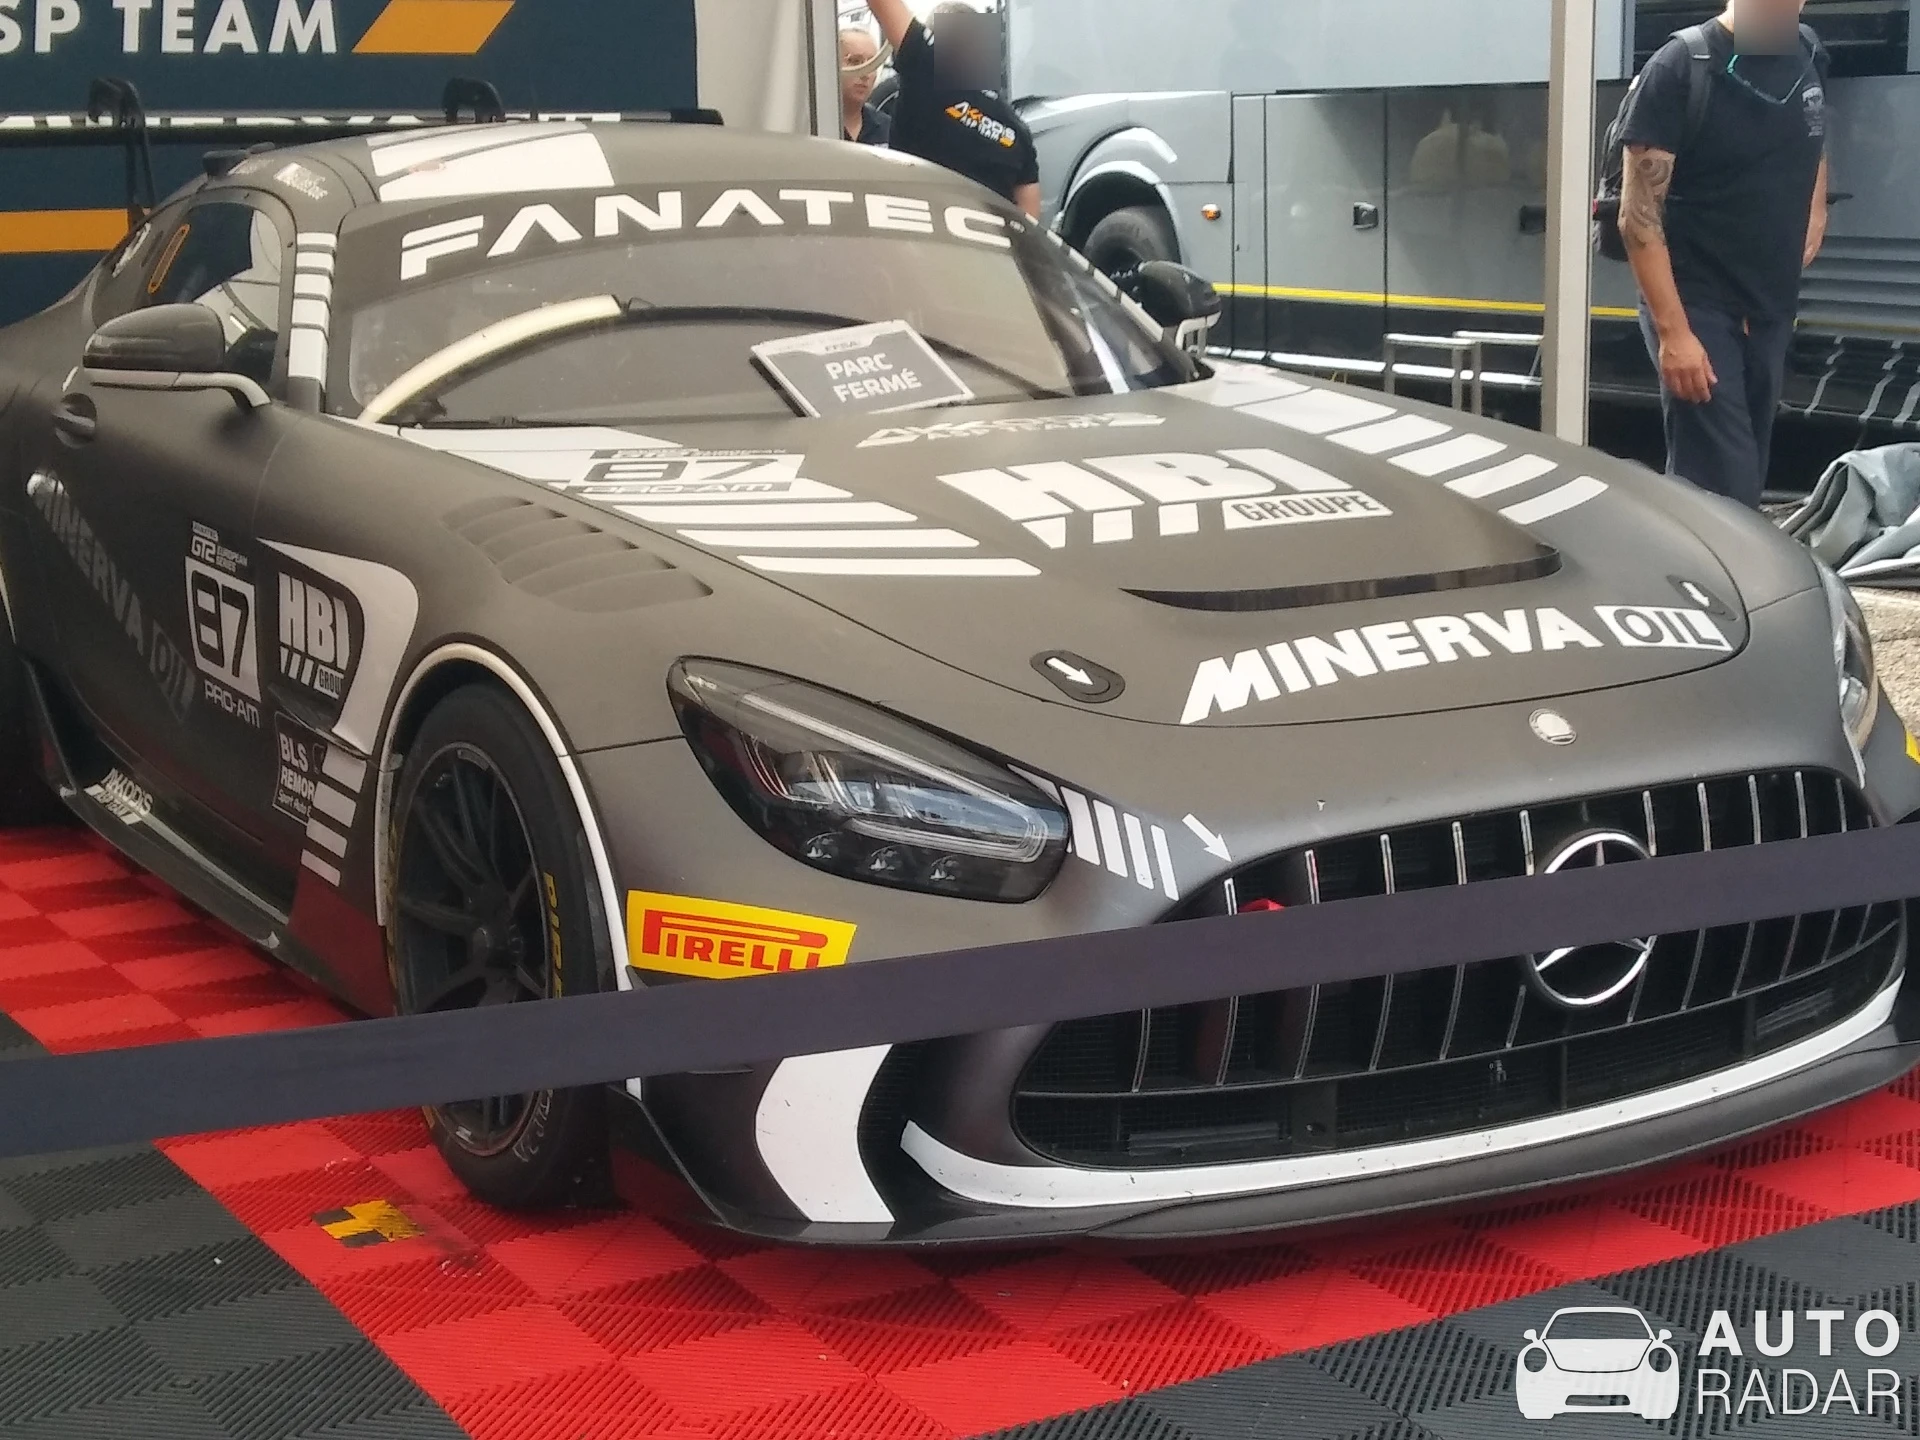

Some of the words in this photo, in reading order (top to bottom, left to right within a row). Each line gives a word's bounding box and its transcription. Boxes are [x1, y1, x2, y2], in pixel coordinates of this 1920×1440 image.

[0, 0, 81, 53] SP
[113, 0, 337, 53] TEAM
[401, 188, 1011, 281] FANATEC
[825, 353, 893, 380] PARC
[833, 368, 922, 403] FERMÉ
[584, 459, 778, 482] 87
[935, 448, 1354, 522] HBI
[1232, 494, 1379, 521] GROUPE
[191, 535, 216, 564] GT2
[191, 569, 249, 679] 87
[279, 572, 350, 671] HBI
[318, 667, 343, 696] GROU
[1180, 607, 1604, 725] MINERVA
[1614, 607, 1725, 647] OIL
[204, 679, 260, 728] PRO-AM
[279, 732, 309, 773] BLS
[642, 909, 828, 973] PIRELLI
